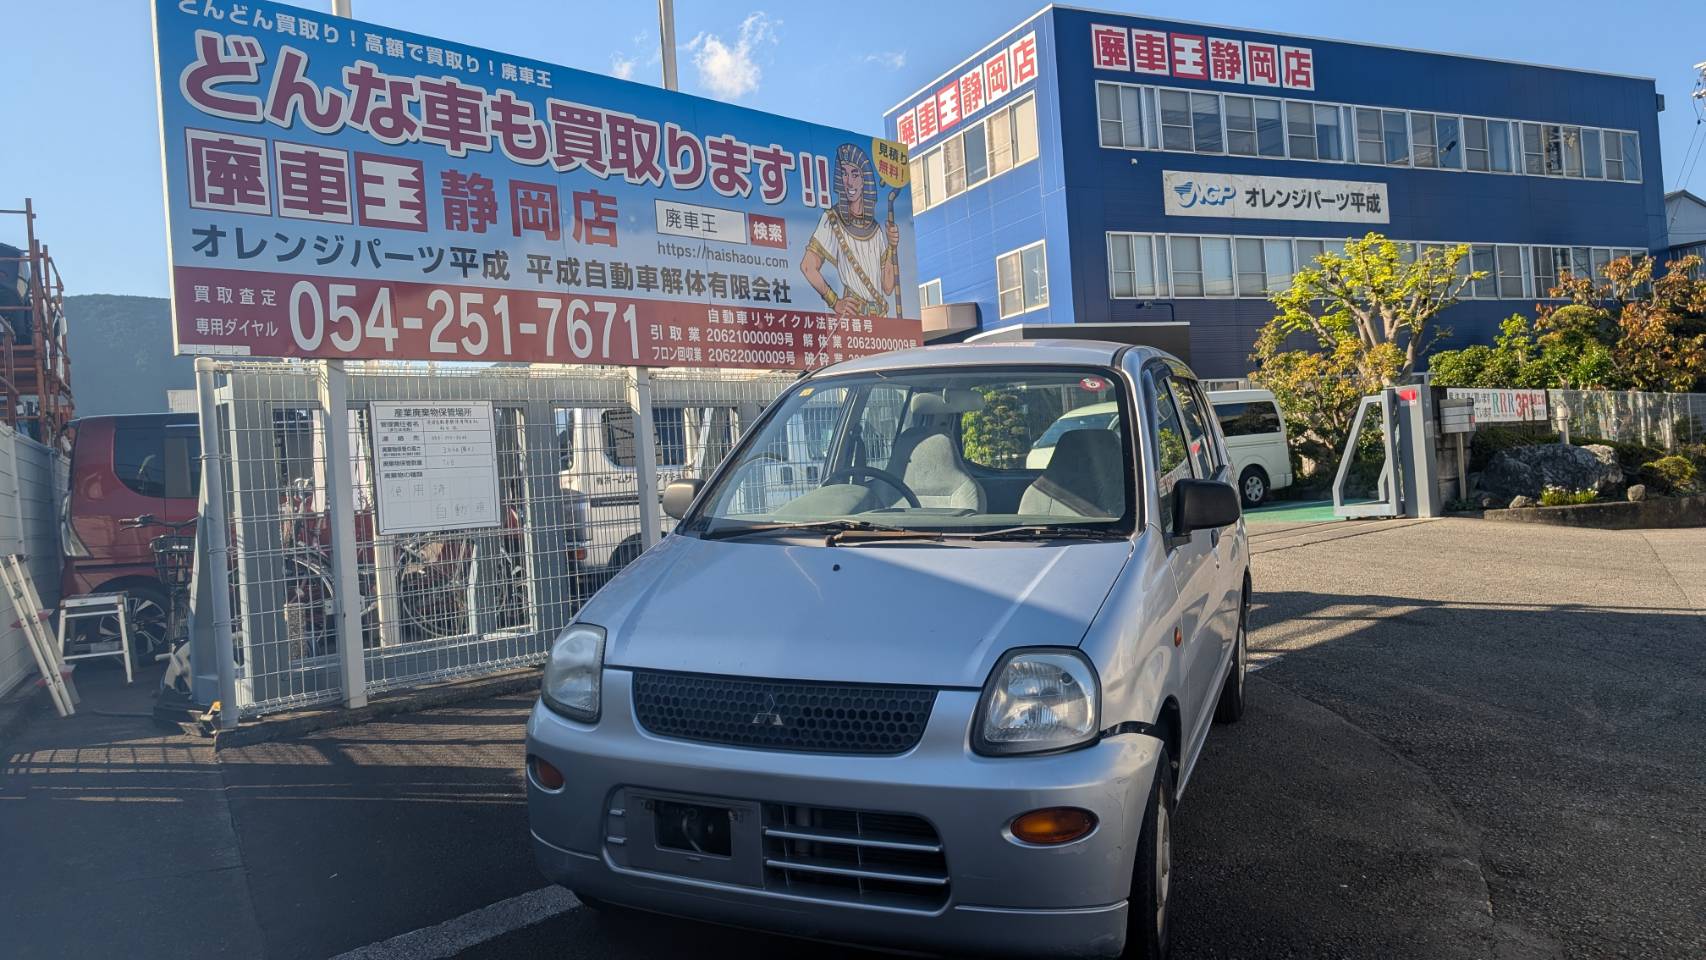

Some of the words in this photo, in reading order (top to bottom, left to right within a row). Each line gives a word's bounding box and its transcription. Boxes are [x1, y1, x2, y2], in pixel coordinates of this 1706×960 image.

[1091, 23, 1315, 91] 廃車王静岡店
[897, 31, 1038, 150] 廃車王静岡店
[879, 142, 908, 165] 見積り
[185, 128, 428, 232] 廃車王
[441, 169, 619, 248] 静岡店
[1245, 187, 1381, 214] オレンジパーツ平成
[665, 208, 718, 234] 廃車王
[753, 219, 783, 242] 検索
[191, 224, 510, 281] オレンジパーツ平成
[526, 253, 792, 304] 平成自動車解体有限会社
[657, 241, 789, 269] https://haishaou.com
[193, 284, 278, 307] 買取査定
[195, 316, 279, 338] 専用ダイヤル
[289, 280, 640, 360] 054-251-7671
[707, 307, 873, 333] 自動車リサイクル法許可番号
[650, 324, 701, 343] 引取業
[706, 327, 794, 347] 20621000009号
[803, 333, 842, 349] 解体業
[651, 346, 702, 362] フロン回収業
[708, 347, 796, 366] 20622000009号
